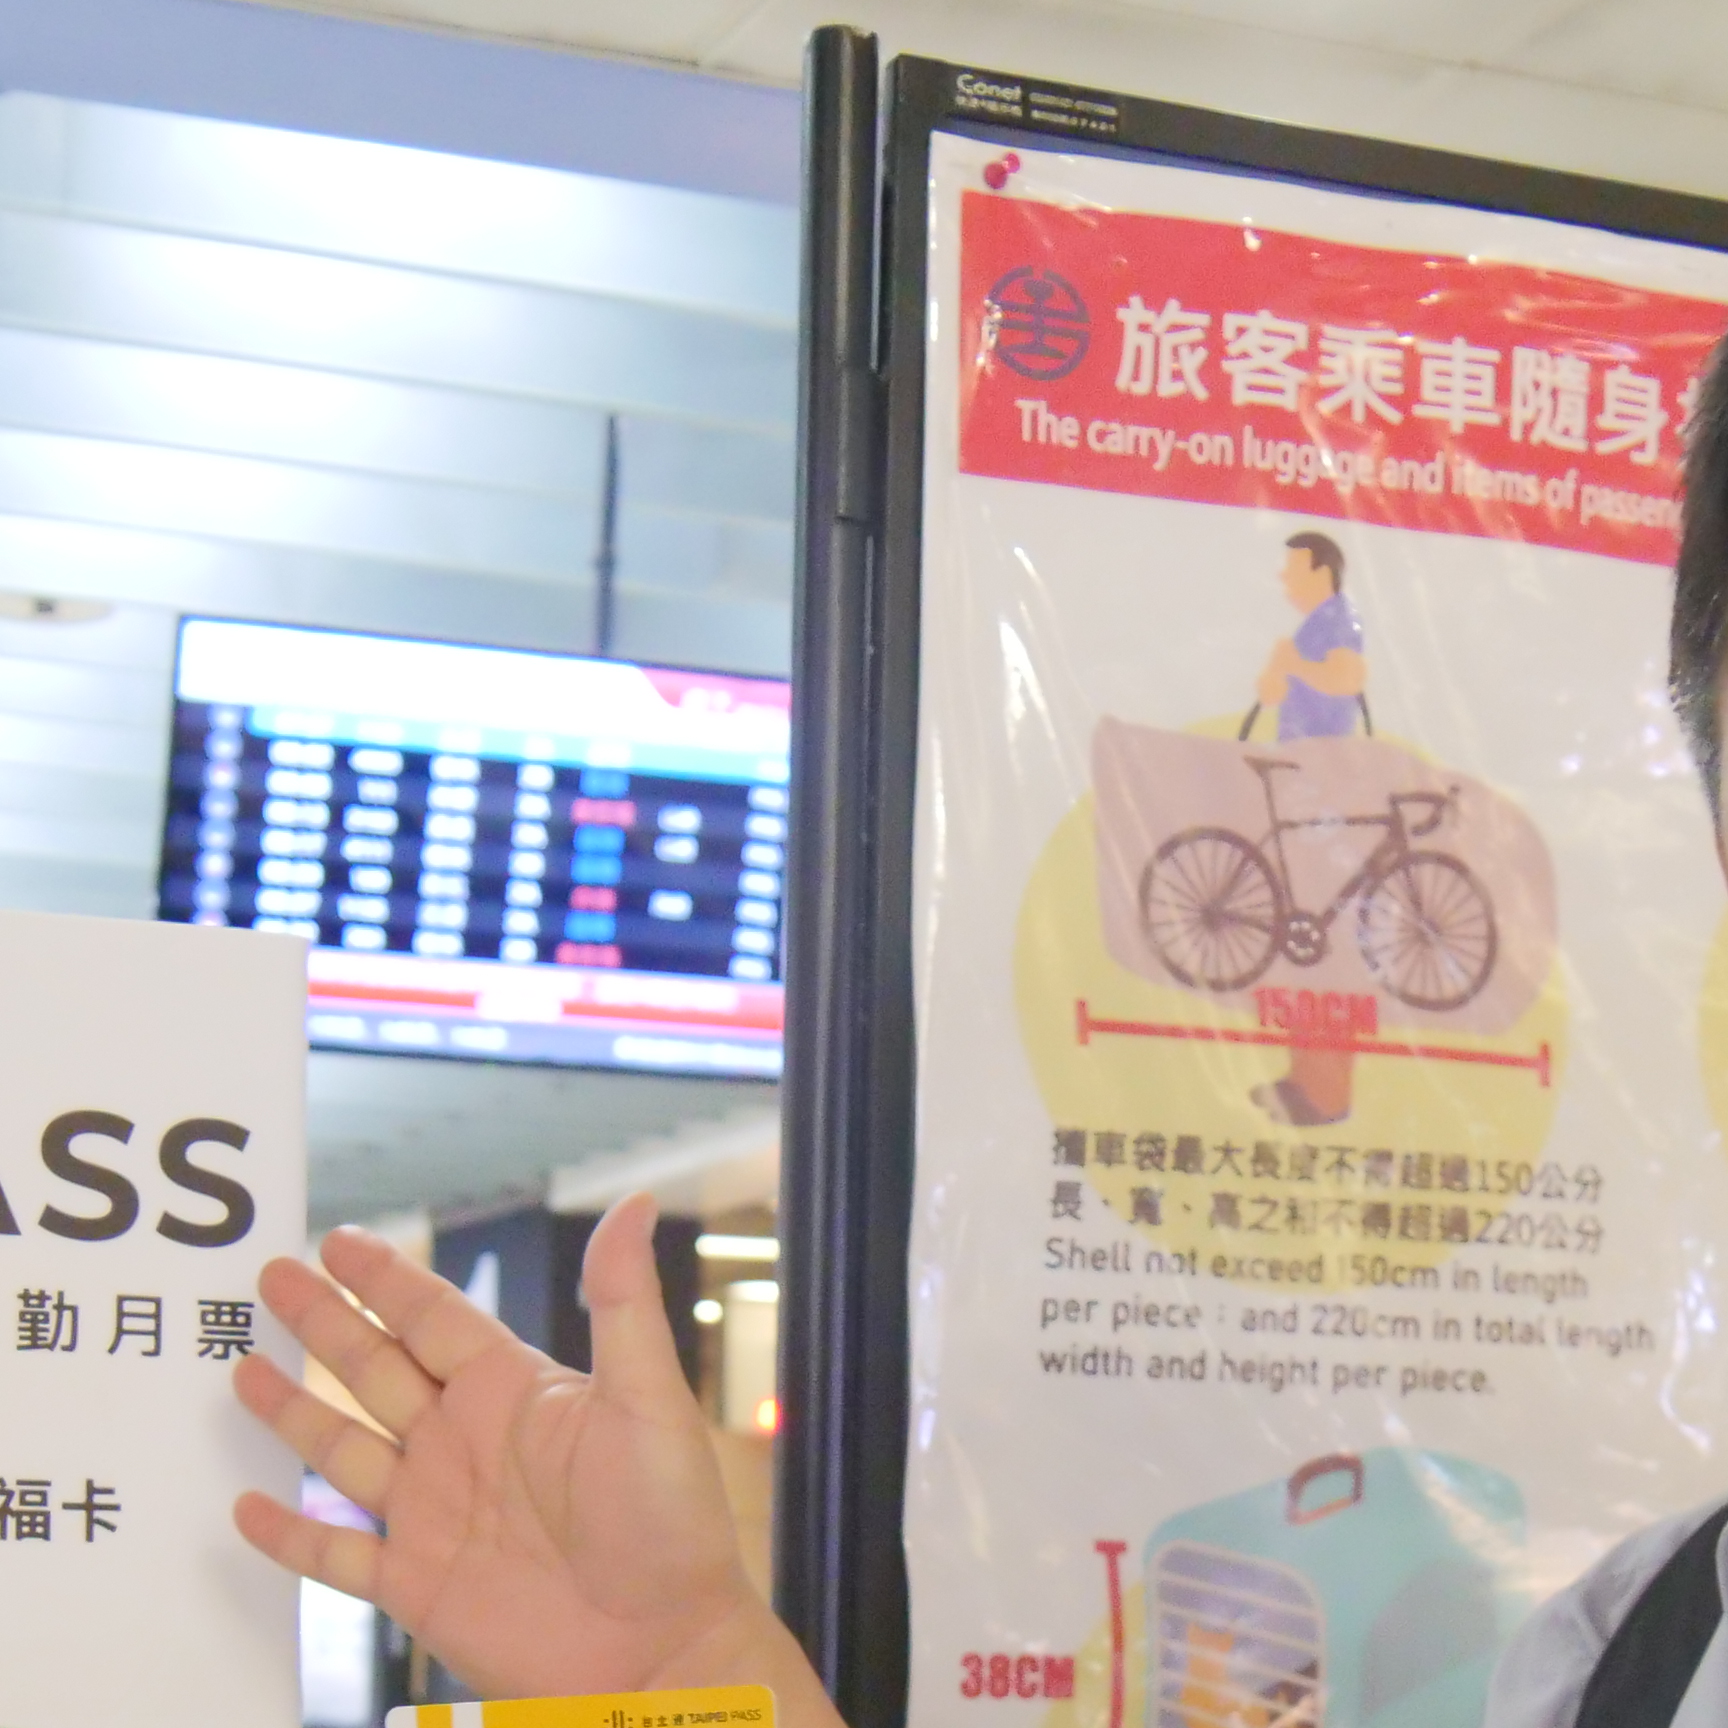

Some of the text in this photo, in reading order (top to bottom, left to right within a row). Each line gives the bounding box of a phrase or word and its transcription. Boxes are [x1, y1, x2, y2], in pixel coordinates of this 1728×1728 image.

[1115, 295, 1698, 465] 旅客乘車隨身
[1015, 397, 1687, 530] The carry-on luggage and items of passen
[1045, 1236, 1131, 1273] Shell
[1210, 1254, 1325, 1284] exceed
[1452, 1260, 1480, 1293] in
[1492, 1262, 1589, 1306] length
[1040, 1298, 1098, 1331] per
[1241, 1303, 1299, 1333] and
[1311, 1304, 1420, 1341] 220cm
[1432, 1306, 1462, 1341] in
[1474, 1312, 1545, 1344] total
[1555, 1315, 1656, 1358] length
[1039, 1343, 1134, 1378] width
[1145, 1350, 1206, 1381] and
[1219, 1350, 1320, 1393] height
[1332, 1362, 1389, 1396] per
[960, 1652, 1076, 1699] 38CM
[688, 1710, 729, 1724] TAIPEI
[730, 1708, 762, 1722] PASS
